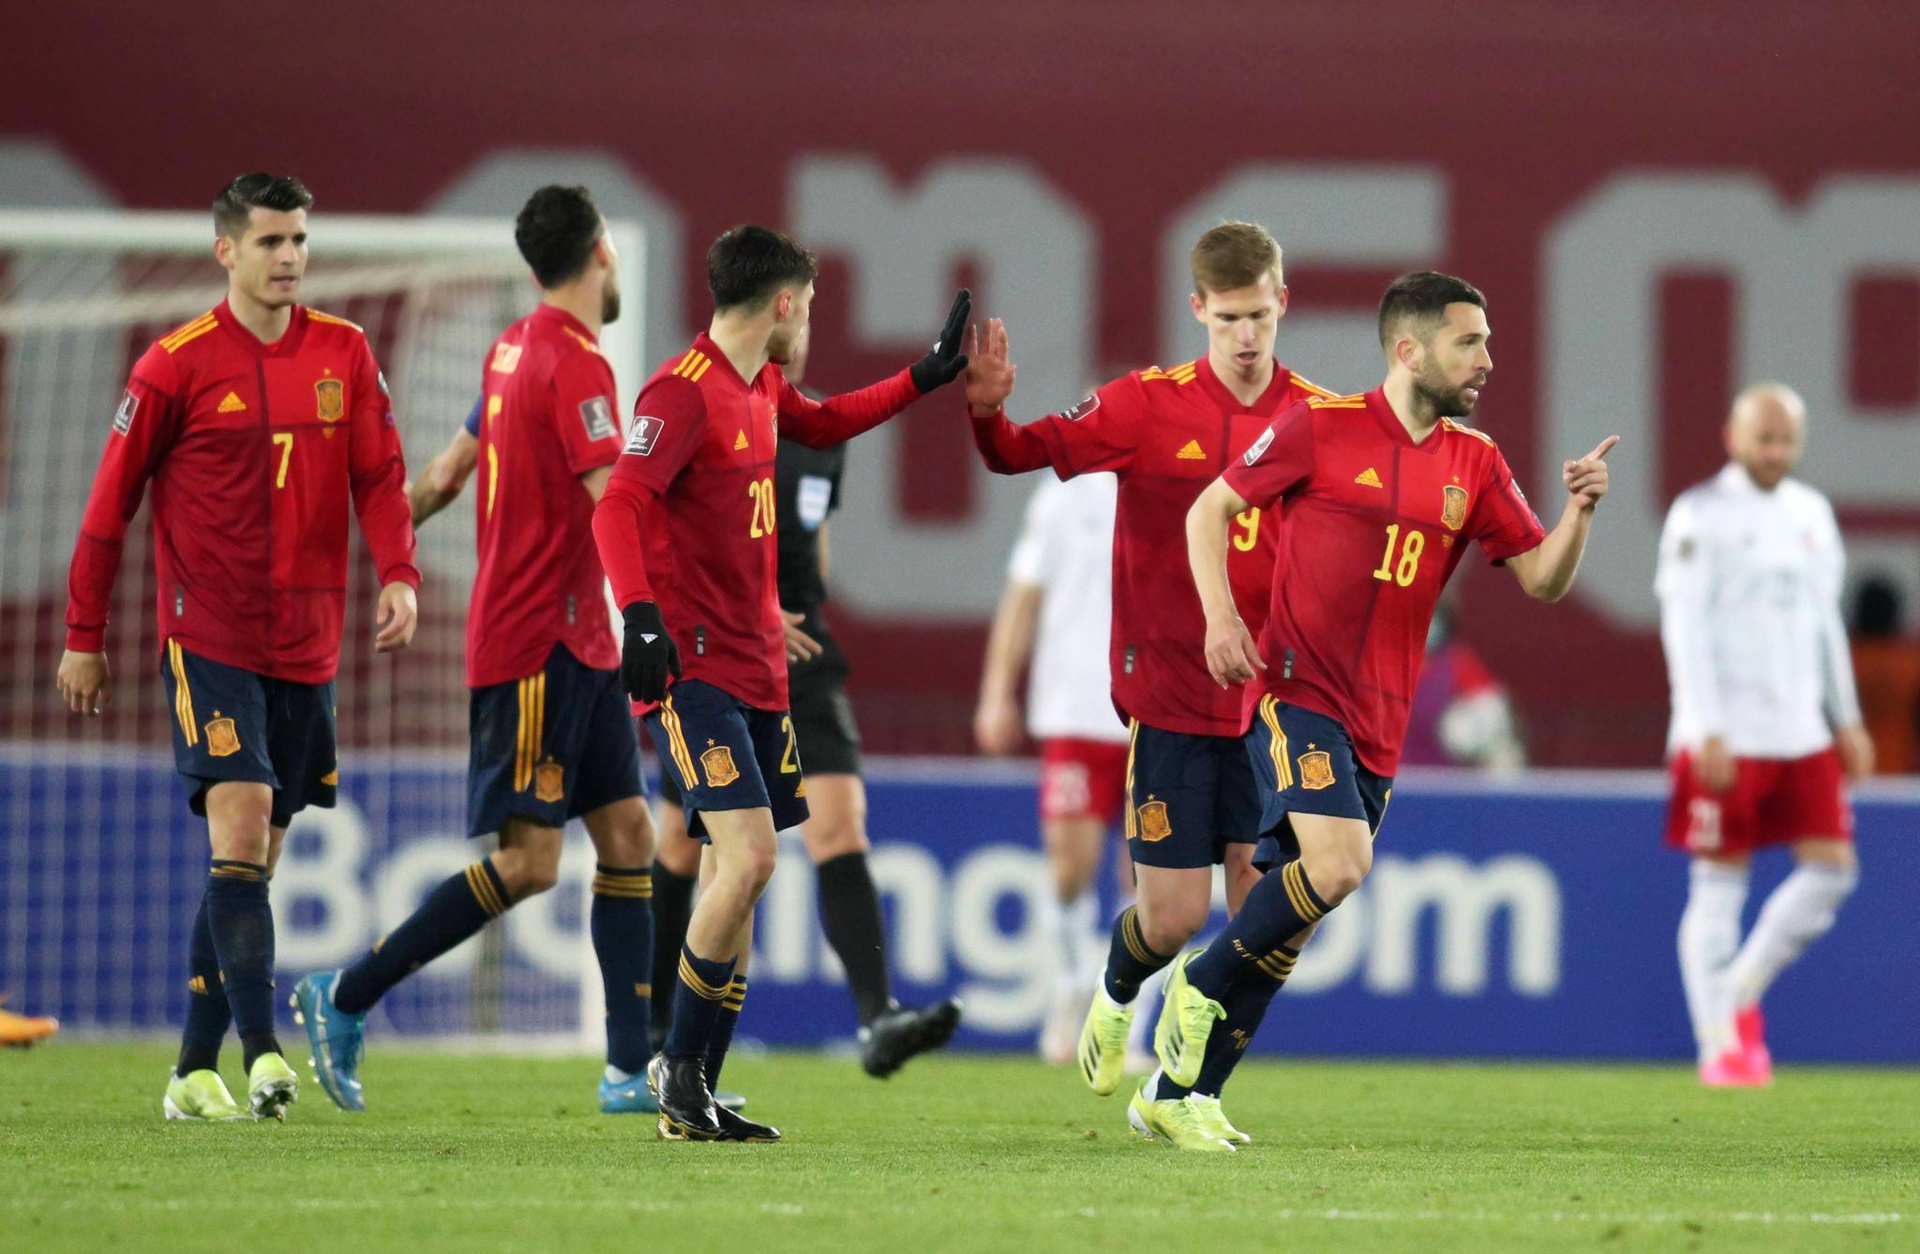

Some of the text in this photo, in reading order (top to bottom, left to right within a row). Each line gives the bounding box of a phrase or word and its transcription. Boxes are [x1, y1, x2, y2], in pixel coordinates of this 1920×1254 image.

[272, 432, 294, 489] 7
[748, 477, 776, 538] 20
[1373, 523, 1425, 587] 18
[780, 715, 803, 775] 2
